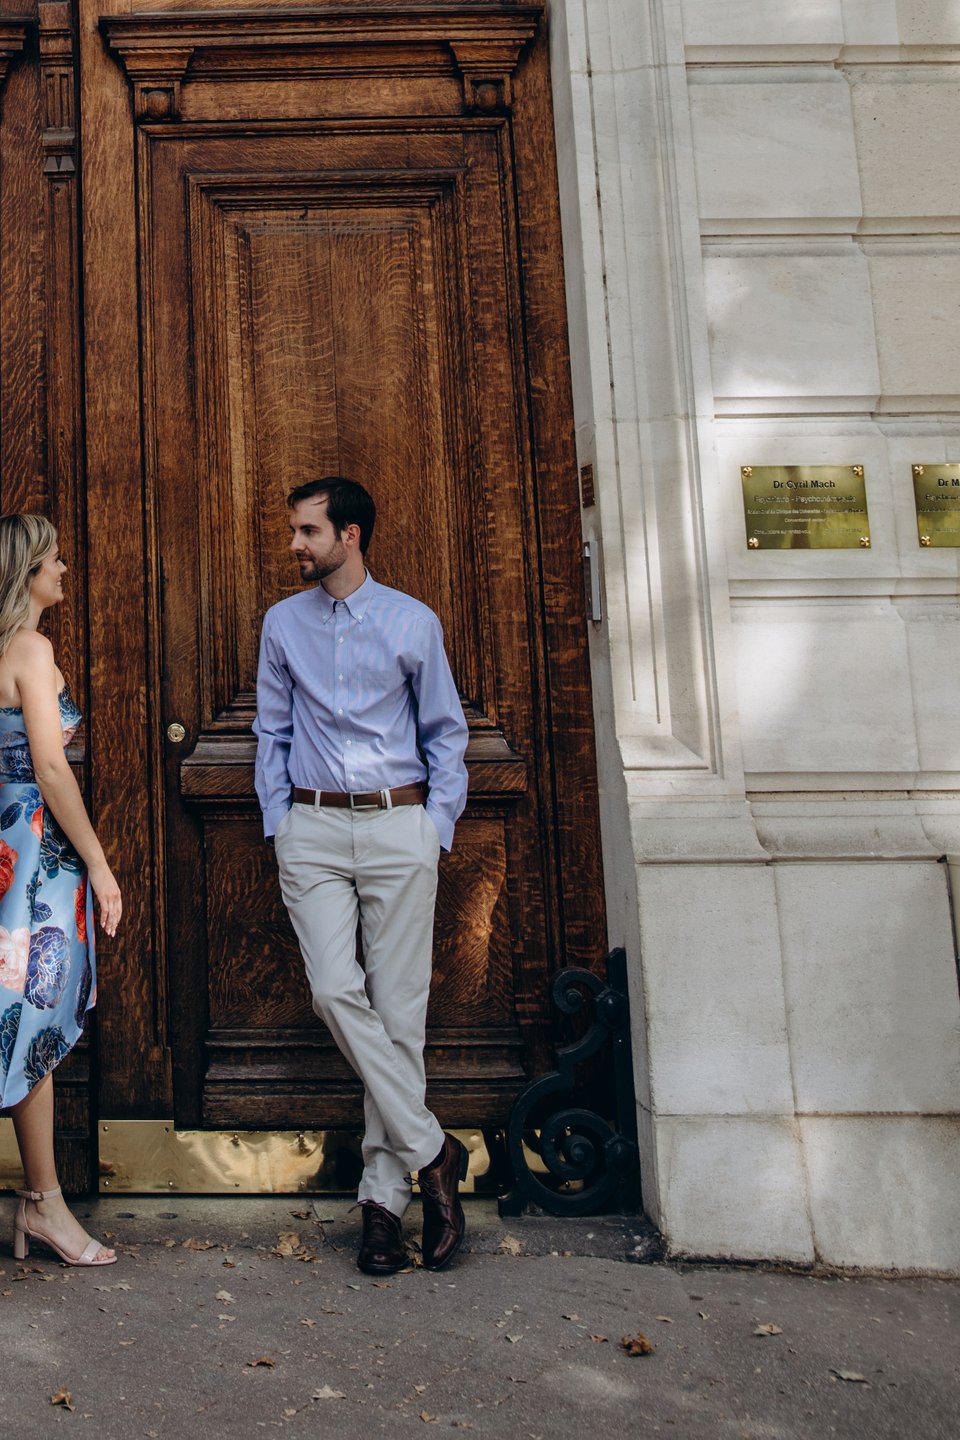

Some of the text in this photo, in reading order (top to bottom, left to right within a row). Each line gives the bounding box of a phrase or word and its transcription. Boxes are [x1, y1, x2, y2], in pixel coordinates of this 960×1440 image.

[773, 480, 784, 489] Dr
[810, 480, 836, 489] Mach
[937, 478, 949, 487] Dr
